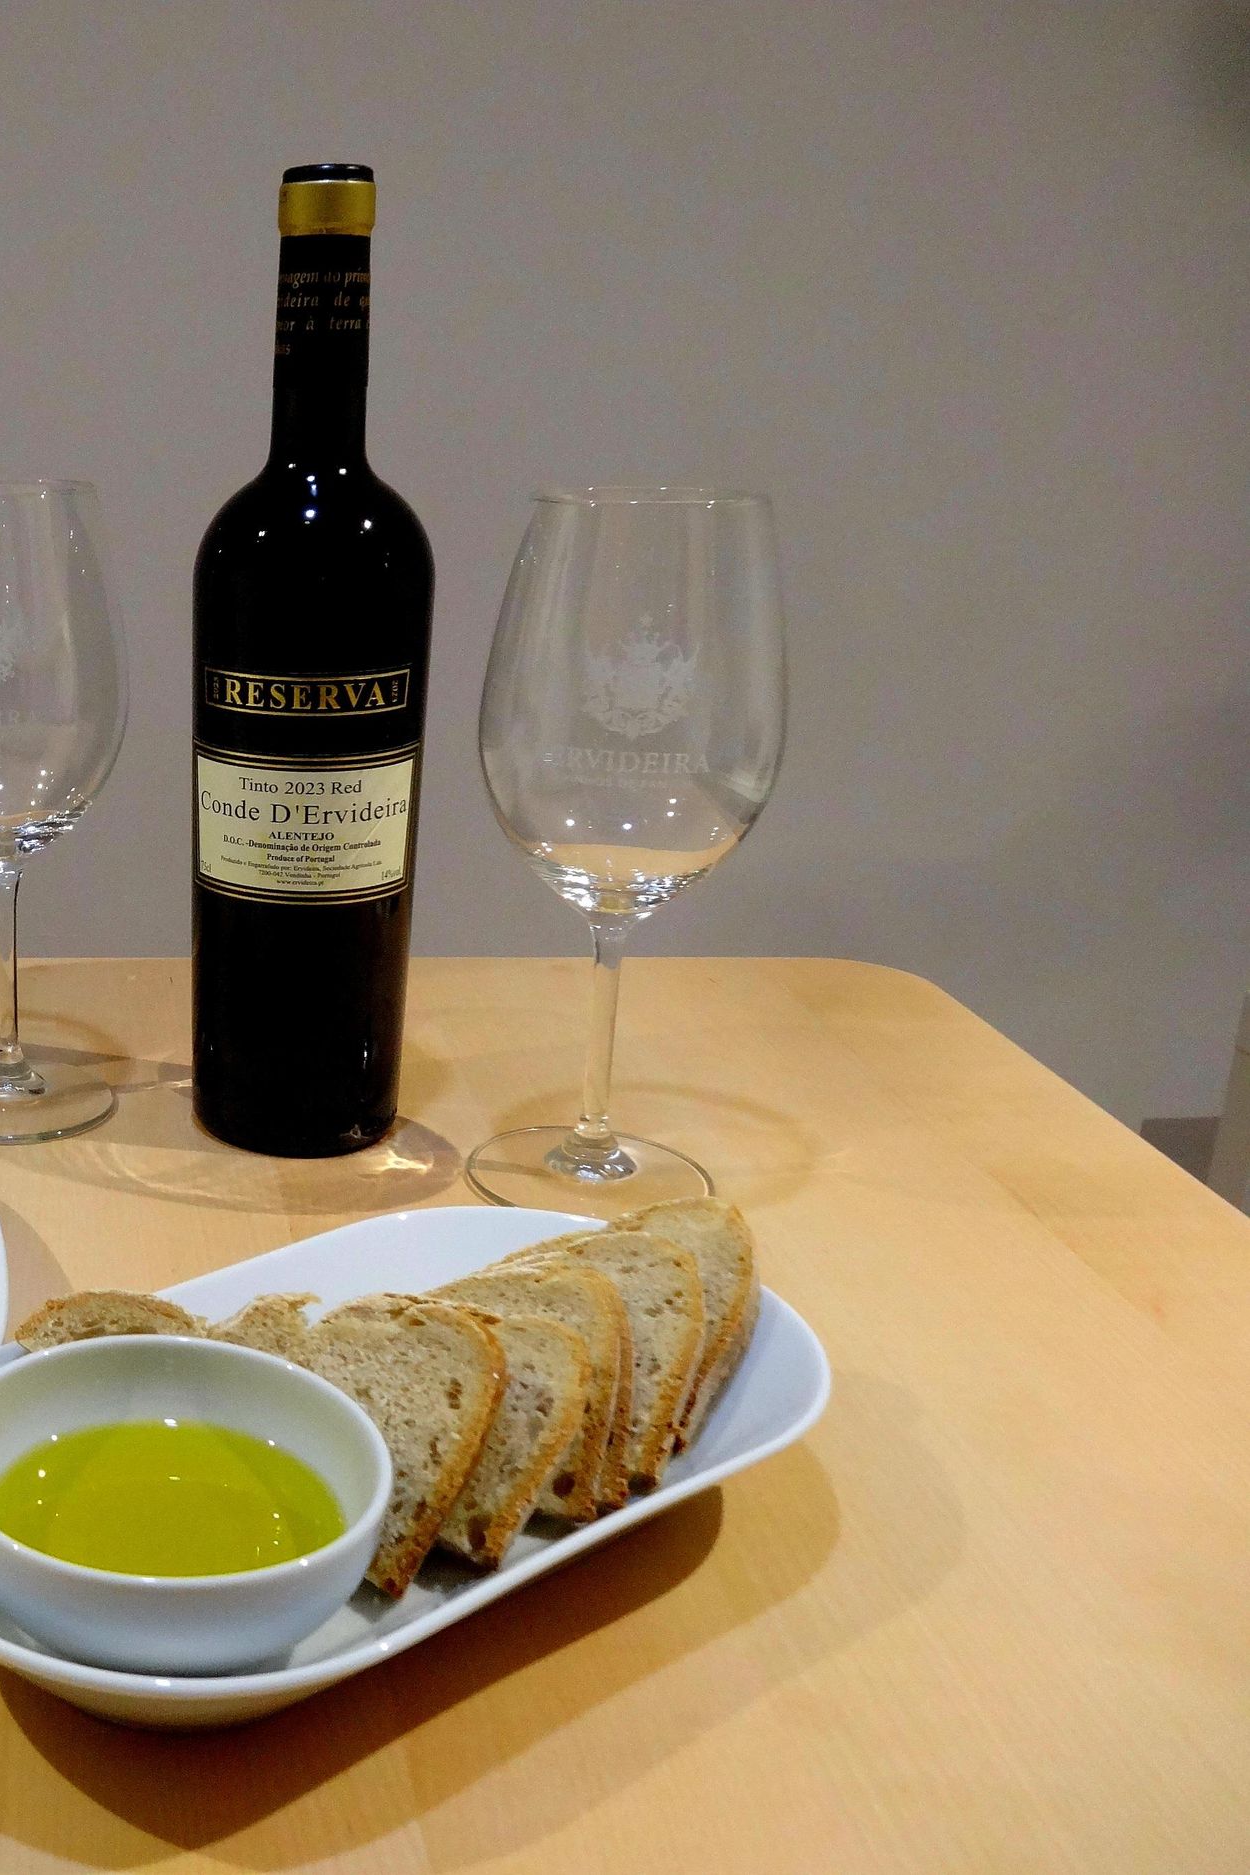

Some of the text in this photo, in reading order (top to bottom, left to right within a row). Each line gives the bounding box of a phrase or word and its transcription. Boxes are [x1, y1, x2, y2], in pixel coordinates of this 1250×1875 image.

[225, 677, 387, 710] RESERVA
[554, 746, 712, 774] RVIDEIRA
[239, 776, 363, 795] Tinto 2023 Red
[201, 790, 408, 825] Conde D'Ervideira
[268, 831, 335, 841] ALENTEJO
[300, 843, 310, 851] de
[312, 843, 342, 853] Origem
[343, 838, 382, 851] Controlada
[266, 853, 335, 863] Produce of Portugal
